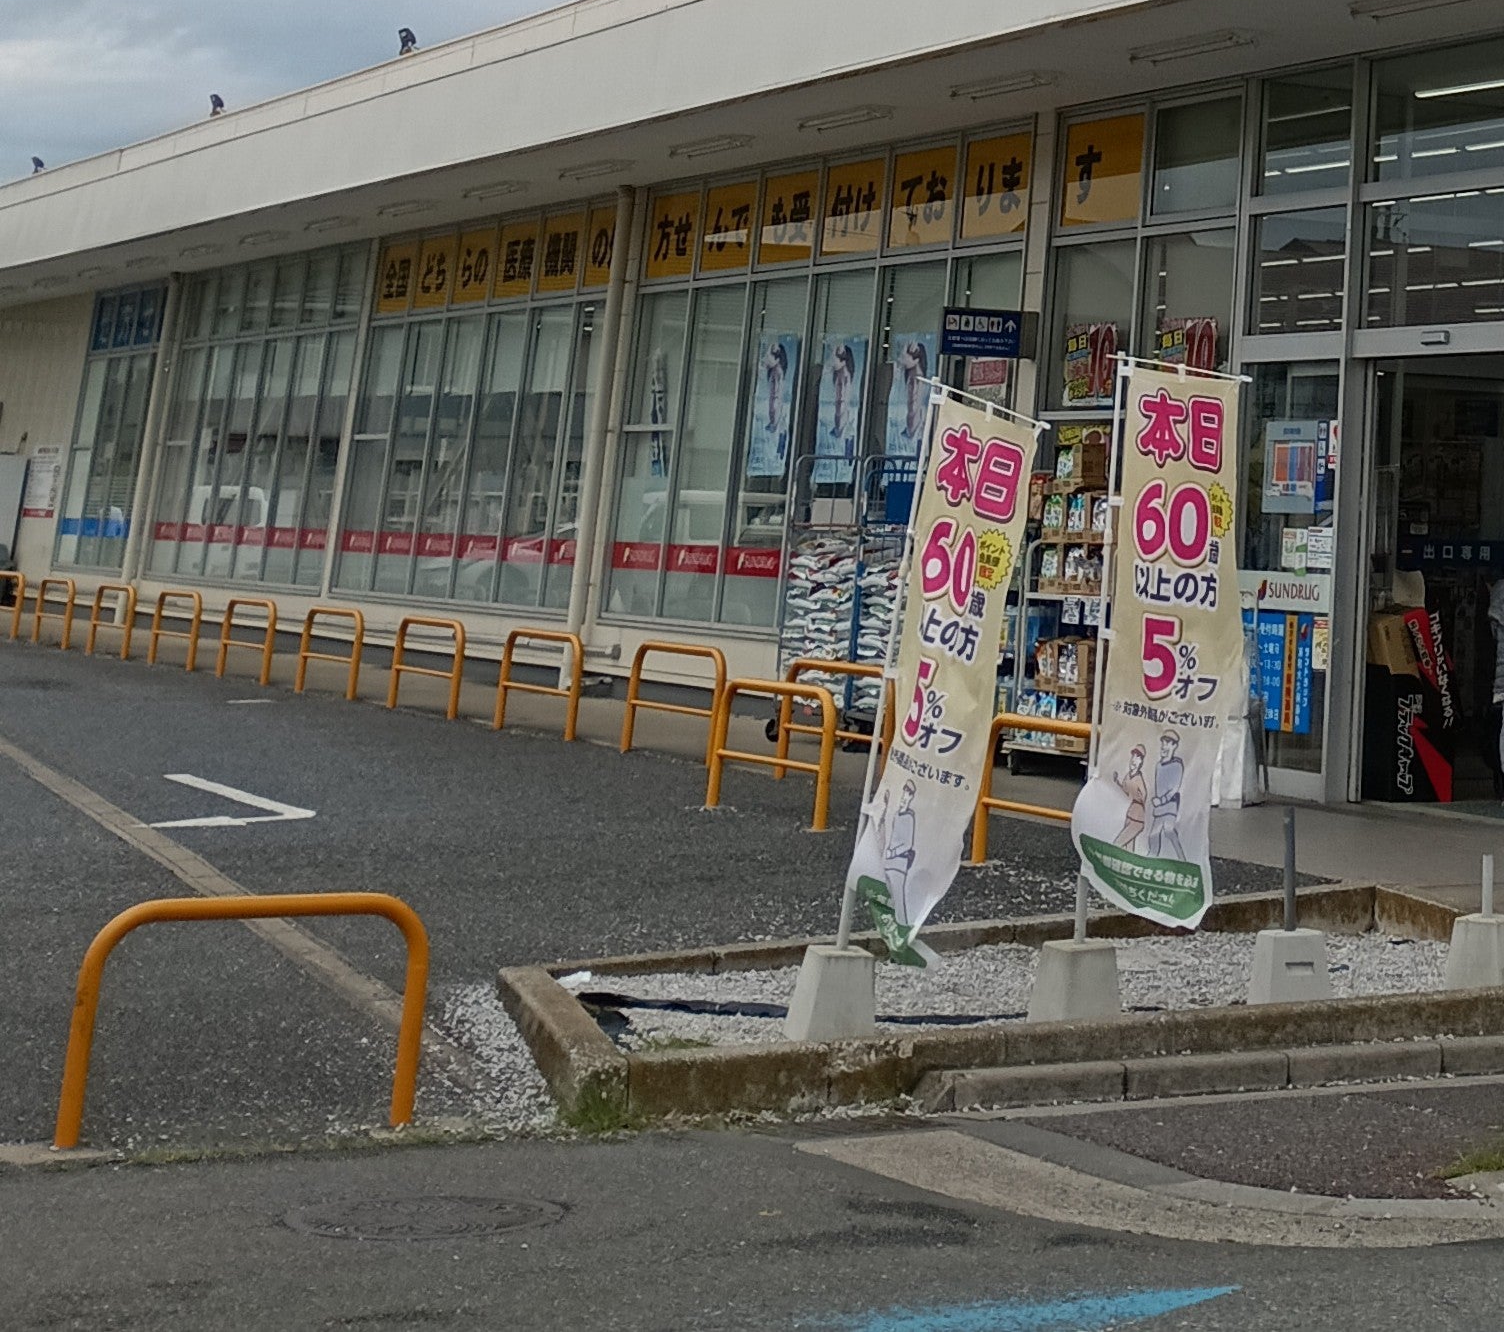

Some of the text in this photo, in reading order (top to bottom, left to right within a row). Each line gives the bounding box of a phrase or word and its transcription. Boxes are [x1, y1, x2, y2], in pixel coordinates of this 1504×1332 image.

[383, 225, 615, 300] 全国どちらの医療機関の
[1137, 387, 1224, 475] 本日
[936, 422, 1026, 525] 本日
[1133, 478, 1211, 568] 60
[1422, 544, 1492, 562] 出口専用
[920, 516, 978, 617] 60
[1134, 563, 1219, 609] 以上の方
[1268, 581, 1320, 602] SUNDRUG
[920, 605, 980, 662] 上の方
[1142, 612, 1198, 701] 5 %
[1174, 674, 1219, 703] オフ
[917, 722, 964, 755] オフ
